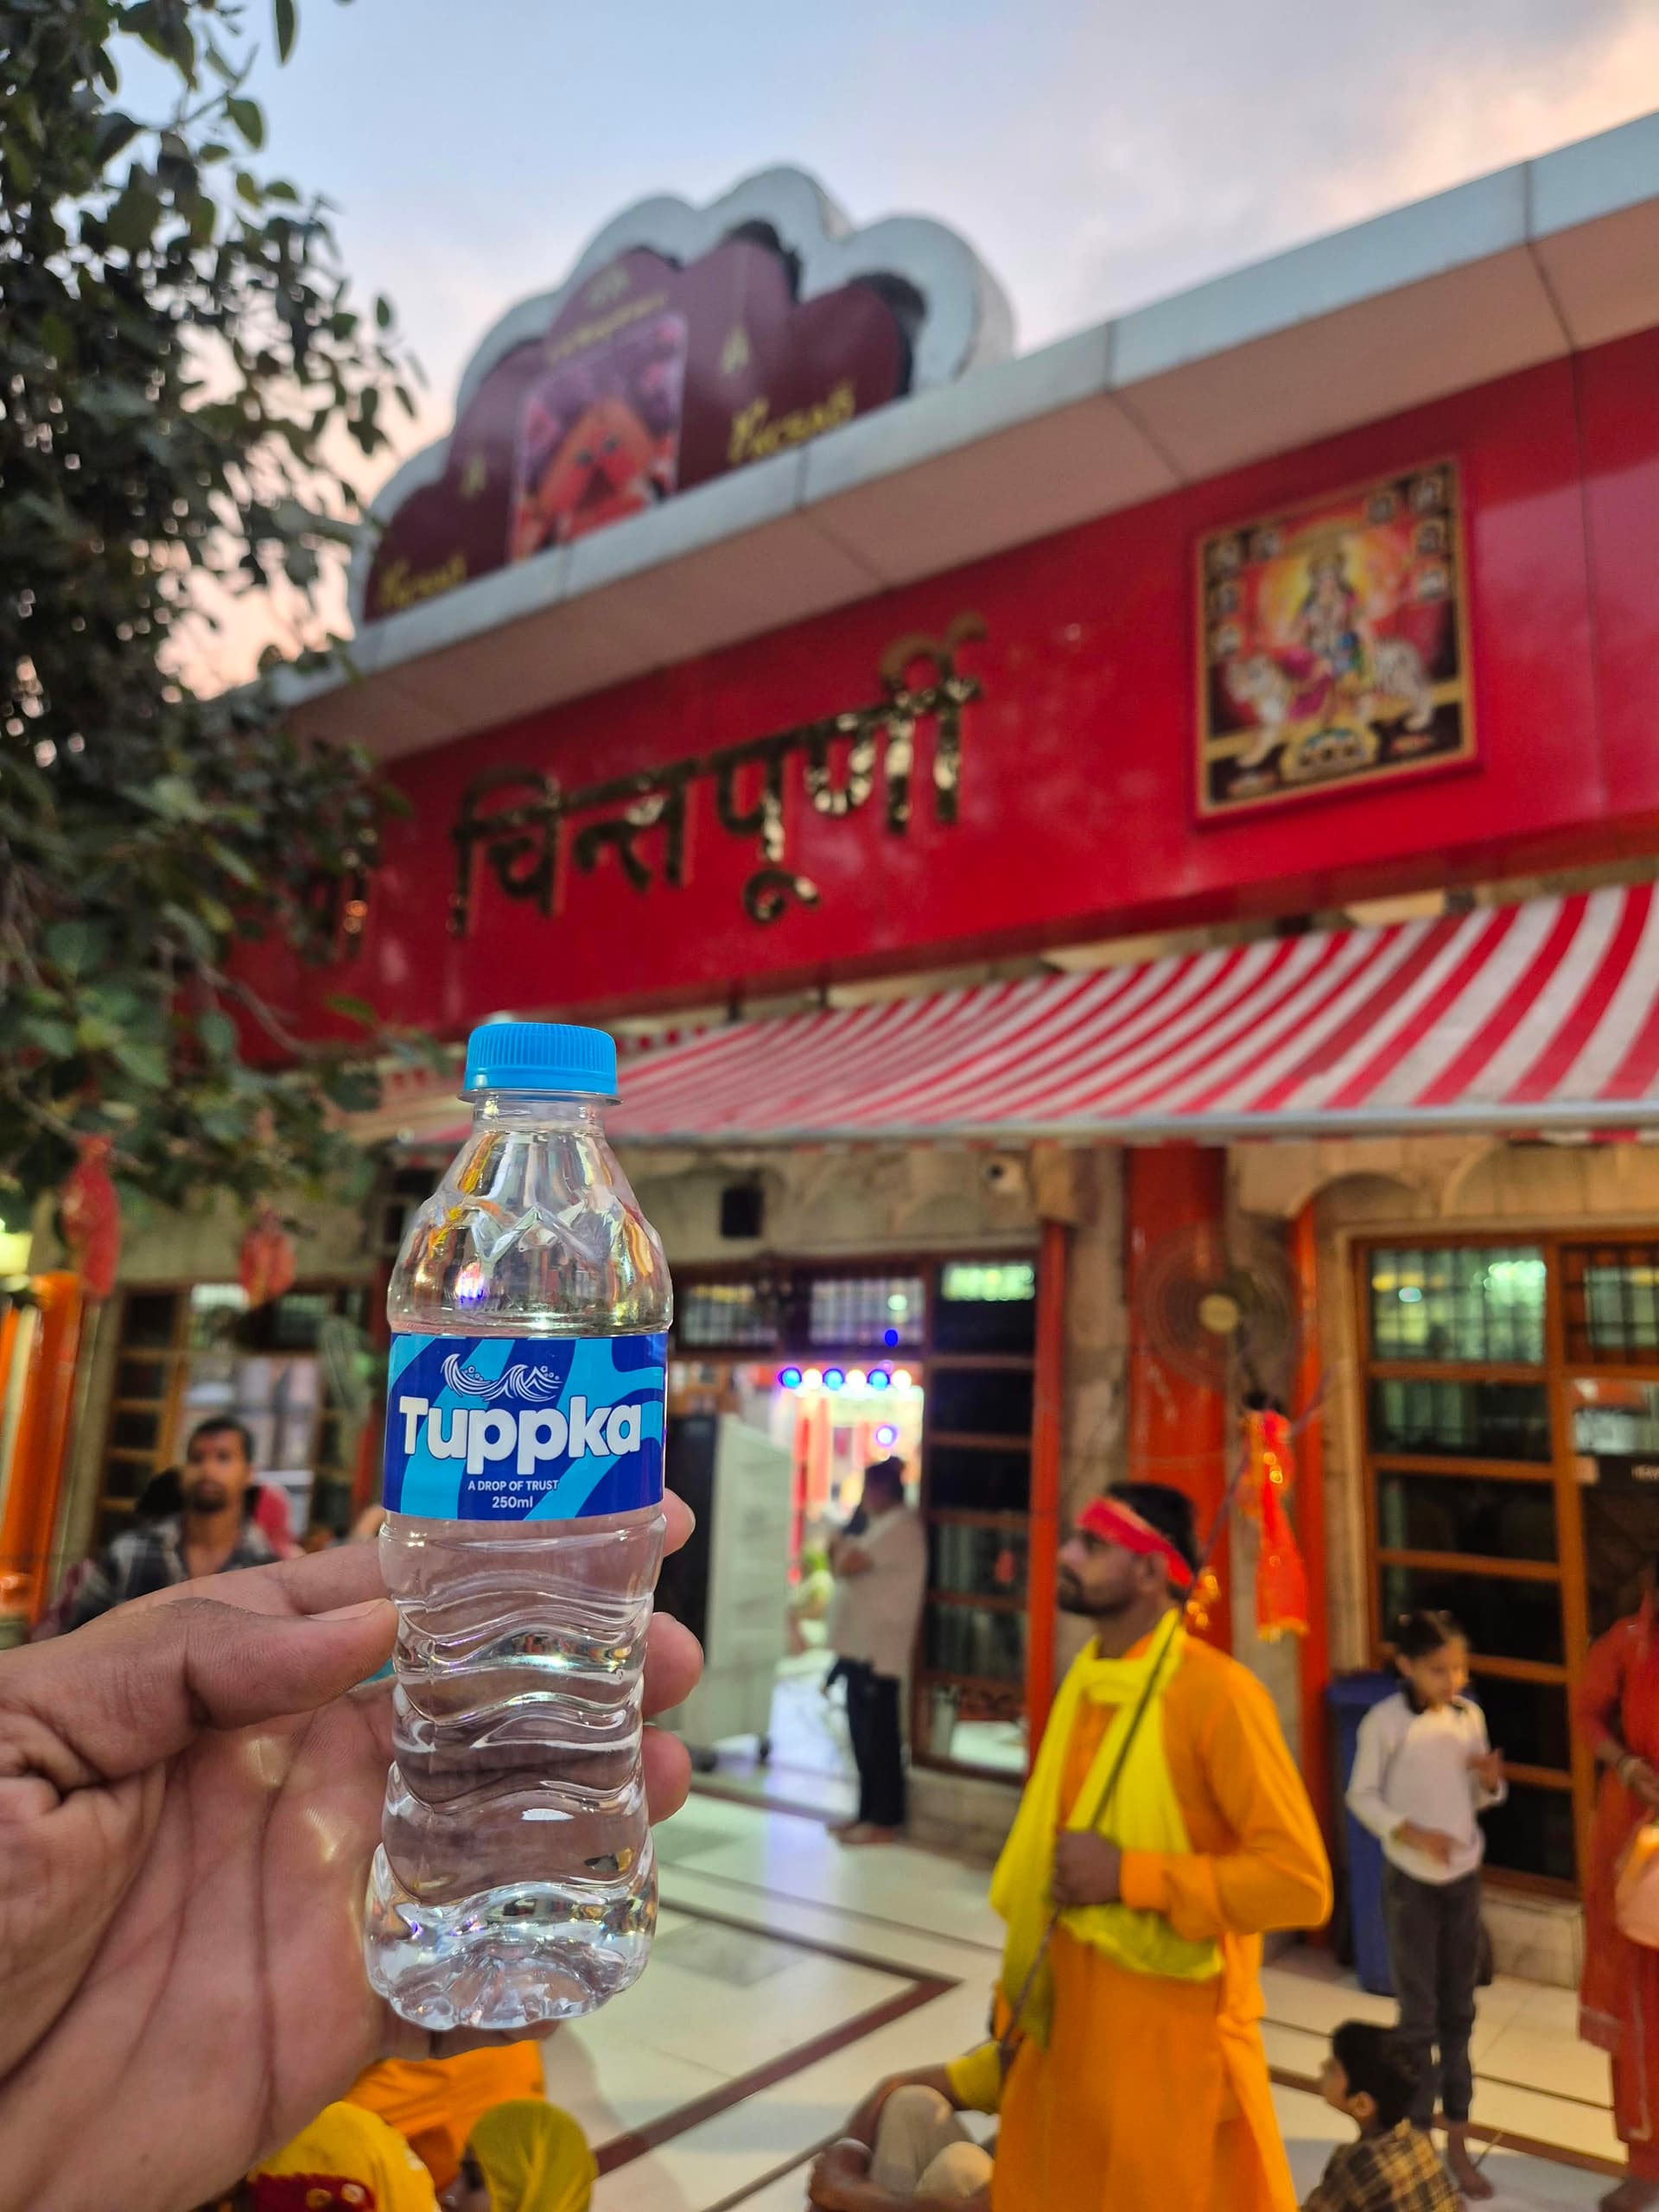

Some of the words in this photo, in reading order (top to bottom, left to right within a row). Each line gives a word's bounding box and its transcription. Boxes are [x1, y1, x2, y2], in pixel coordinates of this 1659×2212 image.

[399, 1395, 641, 1475] Tuppka
[467, 1480, 476, 1491] A
[477, 1480, 507, 1491] DROP
[508, 1480, 524, 1491] OF
[525, 1479, 559, 1491] TRUST
[492, 1495, 534, 1509] 250ml
